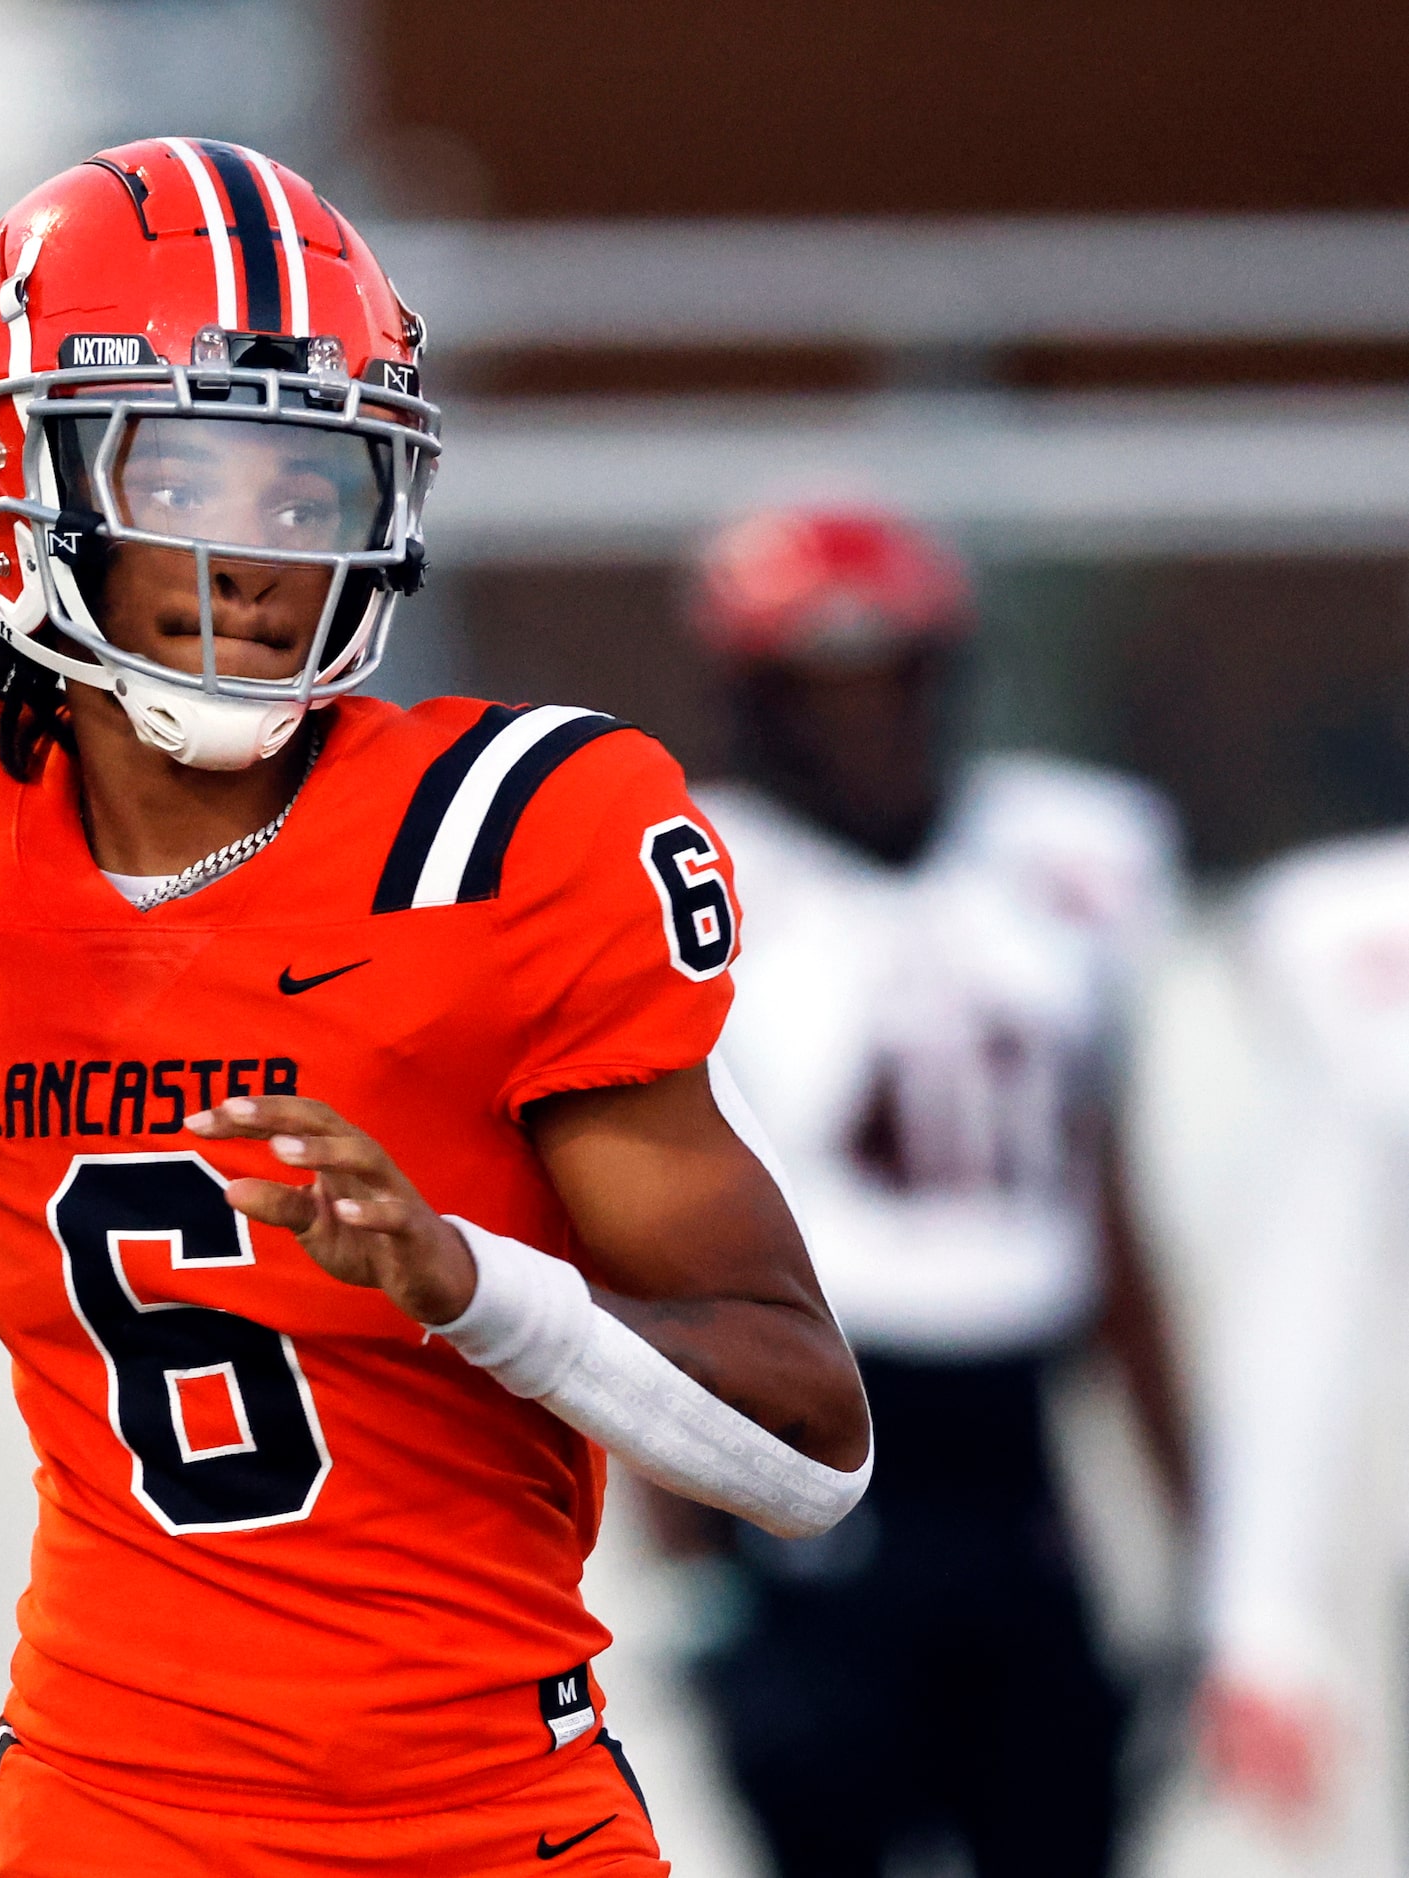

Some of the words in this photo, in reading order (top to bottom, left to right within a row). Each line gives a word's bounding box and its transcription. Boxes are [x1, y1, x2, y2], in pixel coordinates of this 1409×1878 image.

[73, 337, 140, 365] NXTRND
[638, 814, 737, 983] 6
[46, 1150, 333, 1537] 6
[557, 1676, 578, 1706] M
